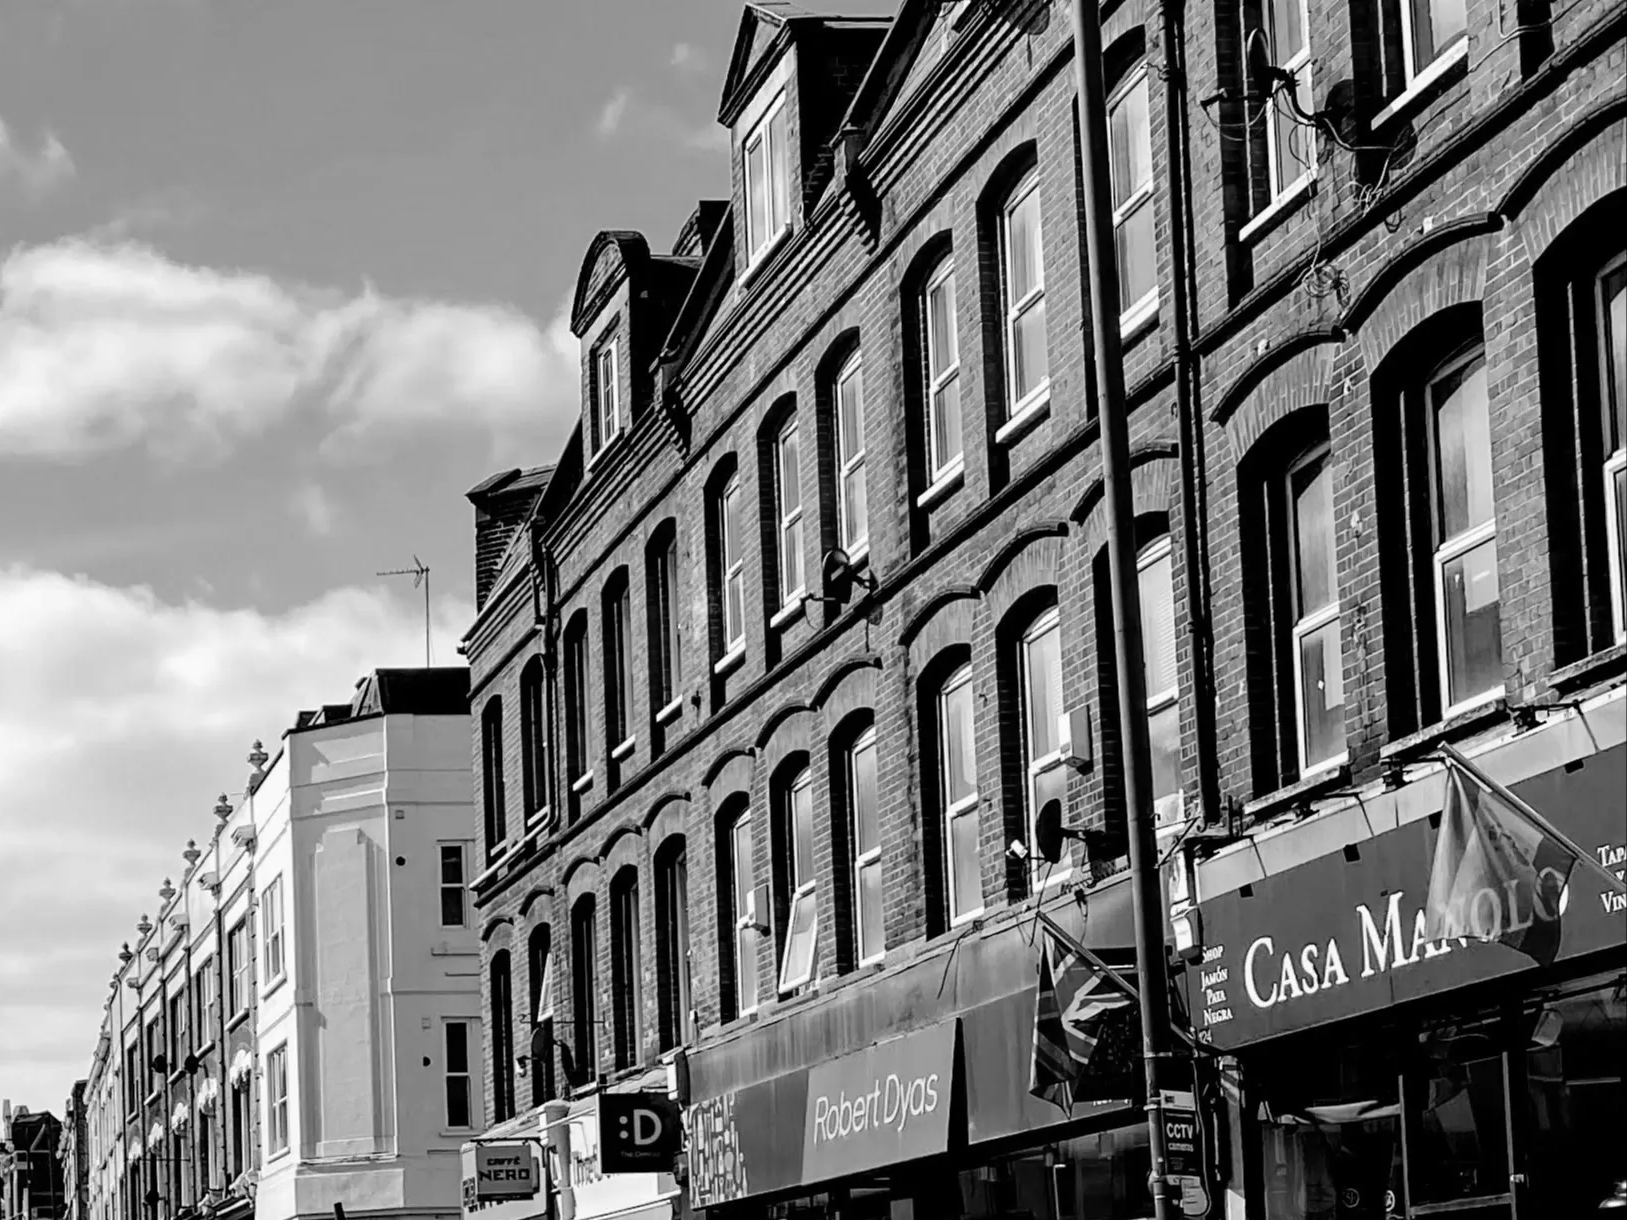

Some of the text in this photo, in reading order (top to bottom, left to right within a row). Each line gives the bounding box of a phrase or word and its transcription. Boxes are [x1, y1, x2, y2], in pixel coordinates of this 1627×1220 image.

[1596, 845, 1626, 868] TAP
[1600, 891, 1626, 914] VIN
[1244, 936, 1351, 1009] CASA
[813, 1073, 939, 1145] Robert Dyas
[1166, 1122, 1194, 1140] CCTV
[477, 1168, 531, 1181] NERO
